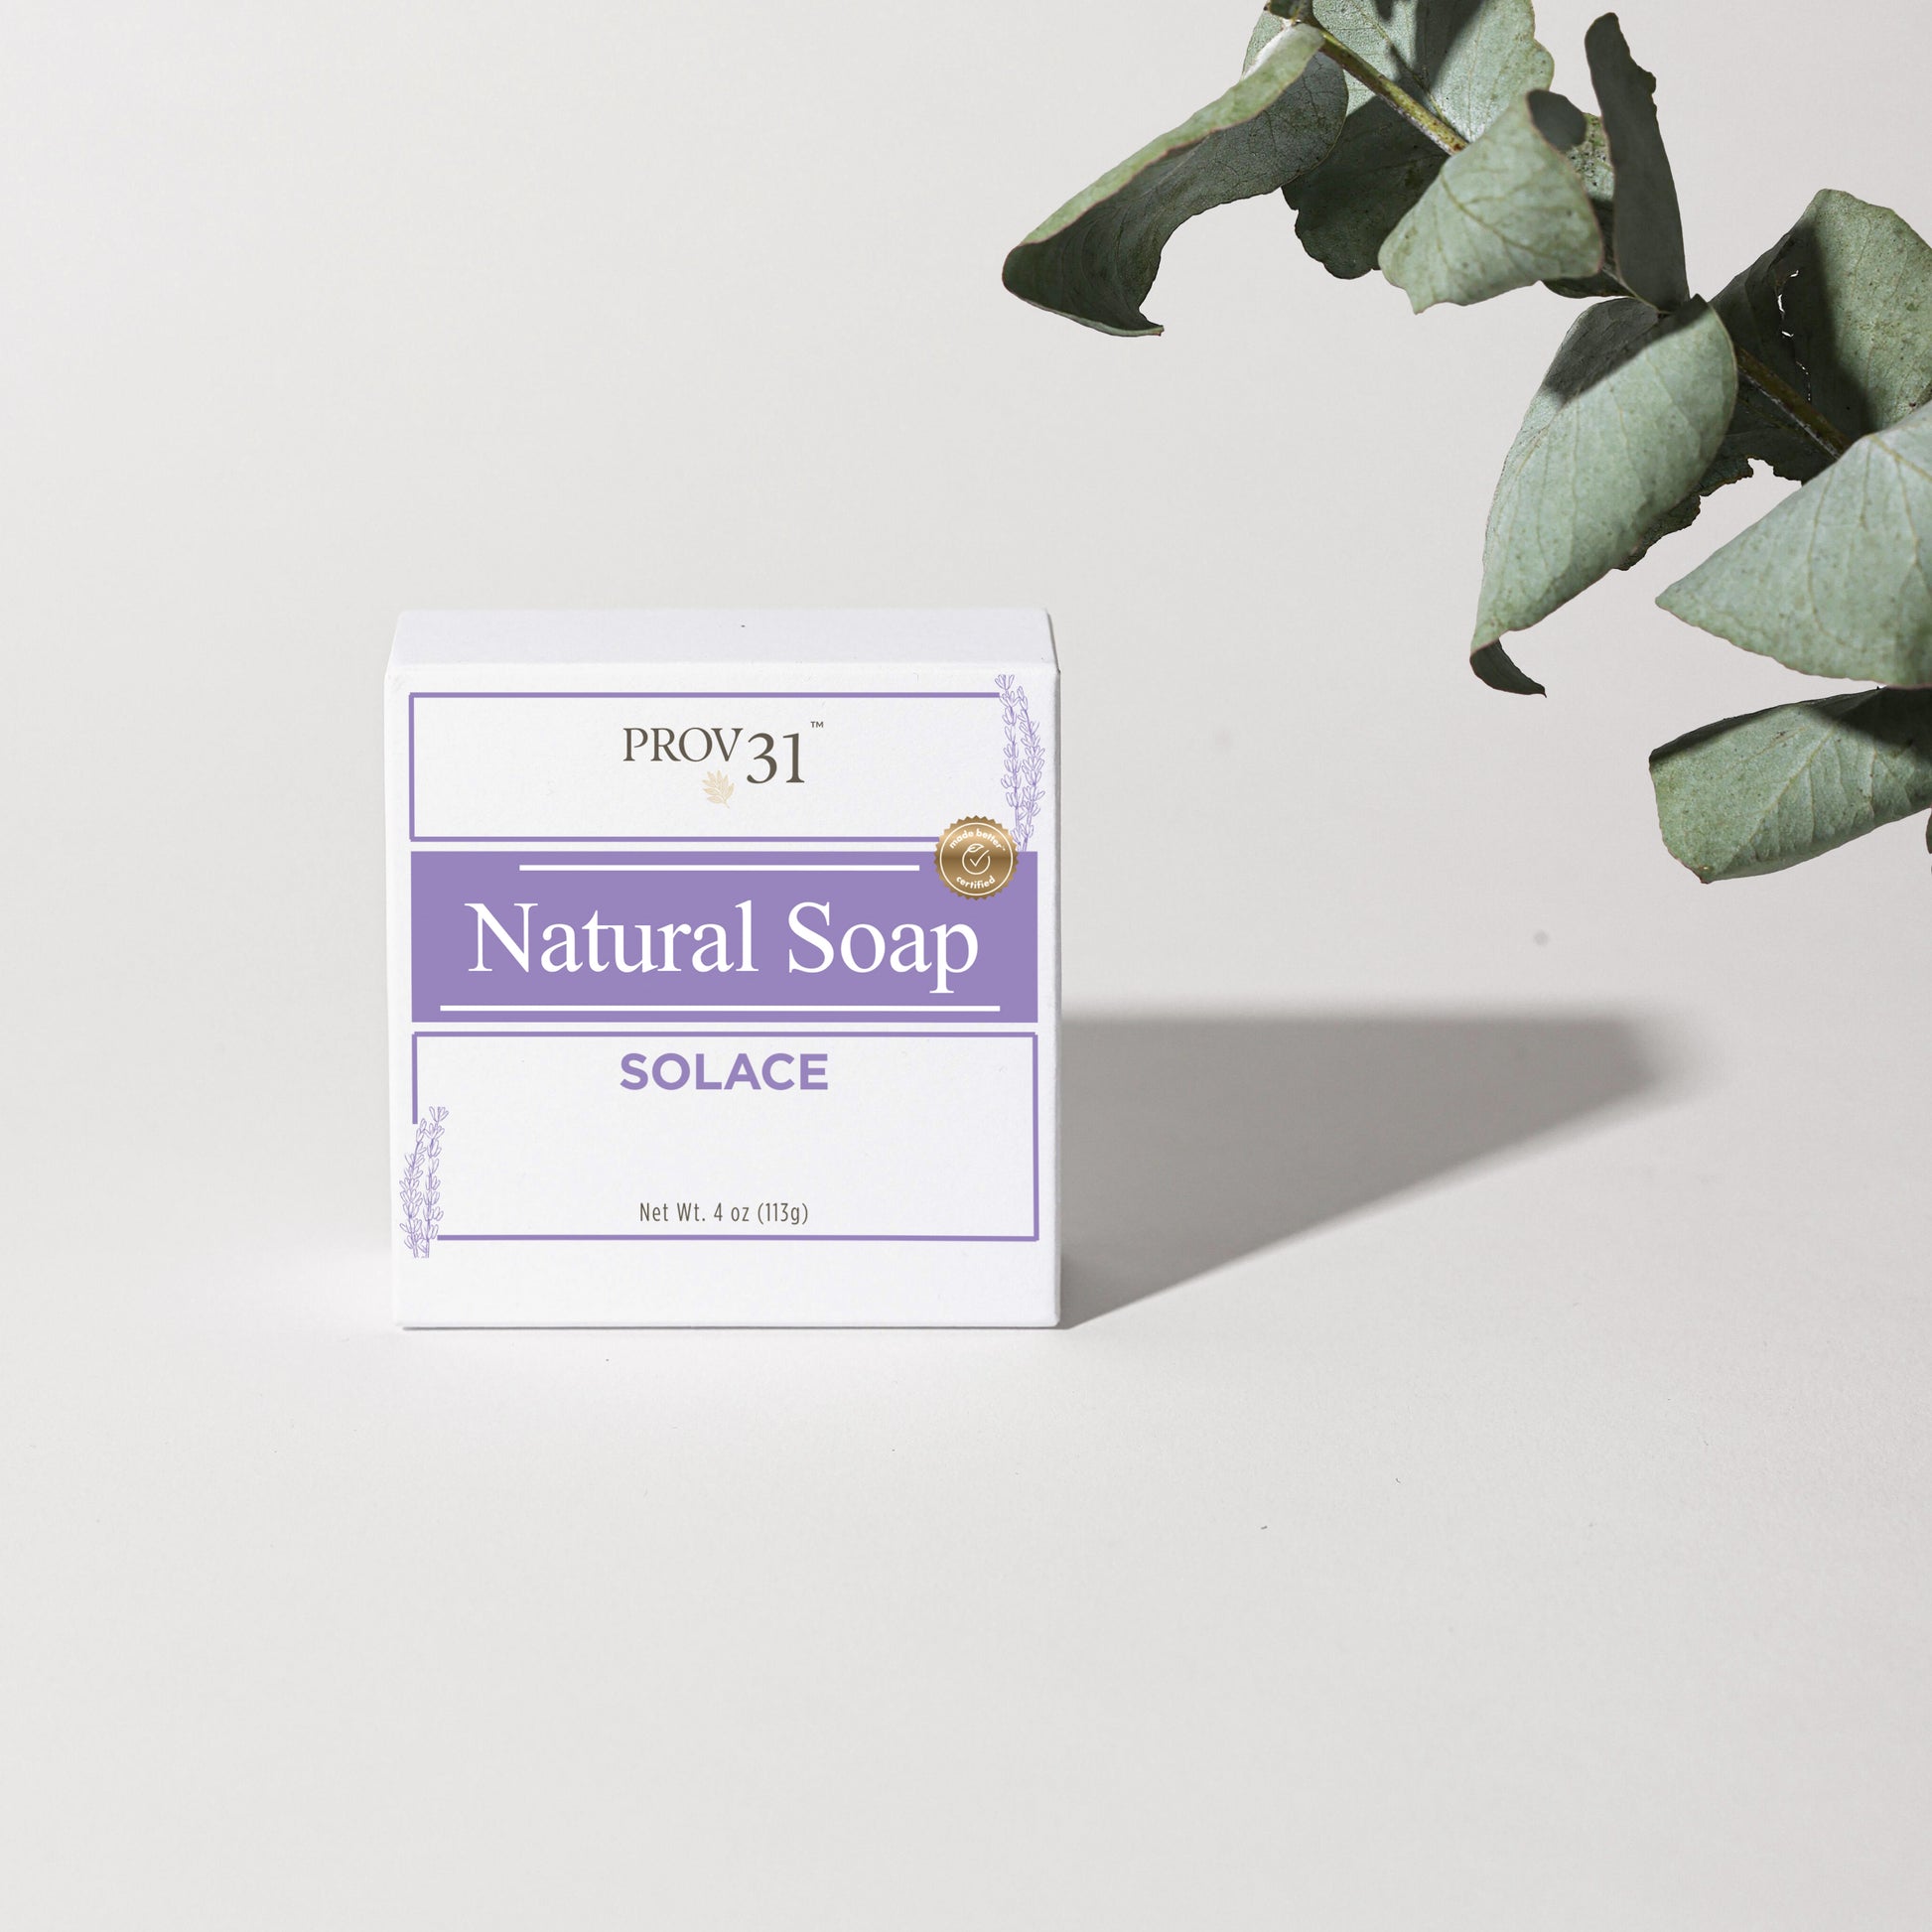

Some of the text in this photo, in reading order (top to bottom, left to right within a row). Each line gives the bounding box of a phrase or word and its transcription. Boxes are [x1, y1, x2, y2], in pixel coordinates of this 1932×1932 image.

[949, 830, 974, 849] made
[956, 875, 996, 889] certified
[464, 899, 979, 994] Natural Soap
[620, 1052, 829, 1091] SOLACE
[639, 1202, 808, 1226] Net Wt. 4 oz (113g)
